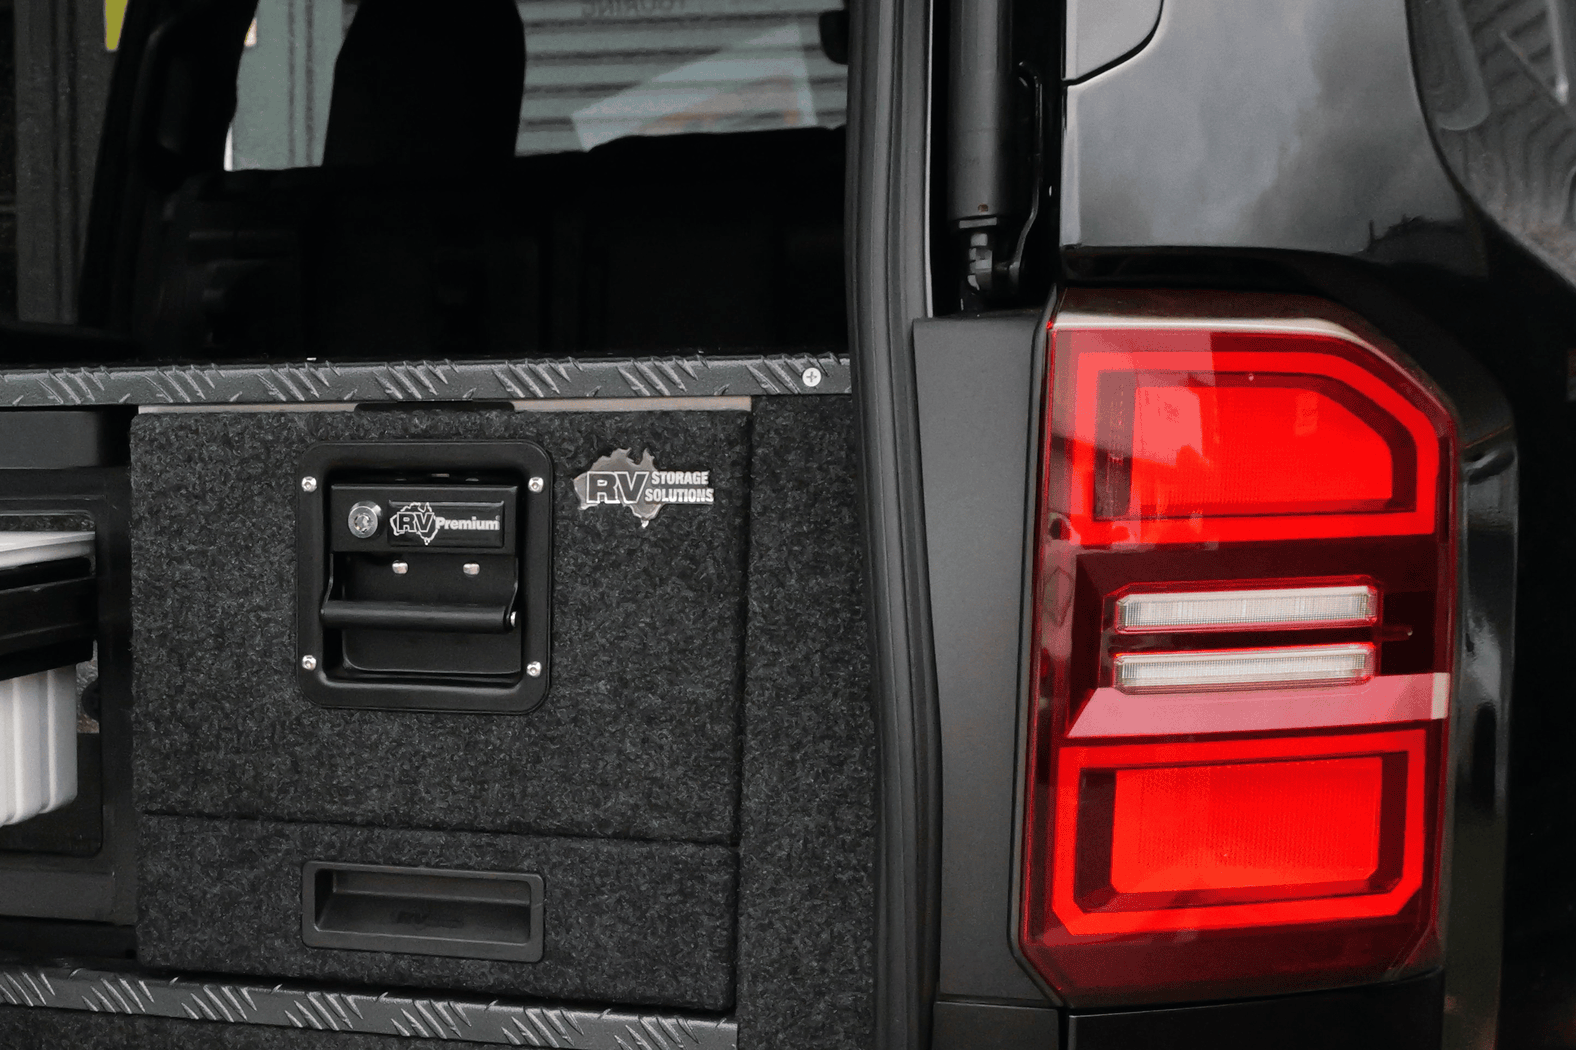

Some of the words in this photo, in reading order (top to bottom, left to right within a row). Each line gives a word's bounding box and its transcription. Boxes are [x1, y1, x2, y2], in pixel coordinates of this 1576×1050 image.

[651, 471, 710, 485] STORAGE
[587, 471, 650, 504] RV
[644, 488, 714, 502] SOLUTIONS
[397, 512, 434, 532] RV
[435, 516, 500, 530] Premium
